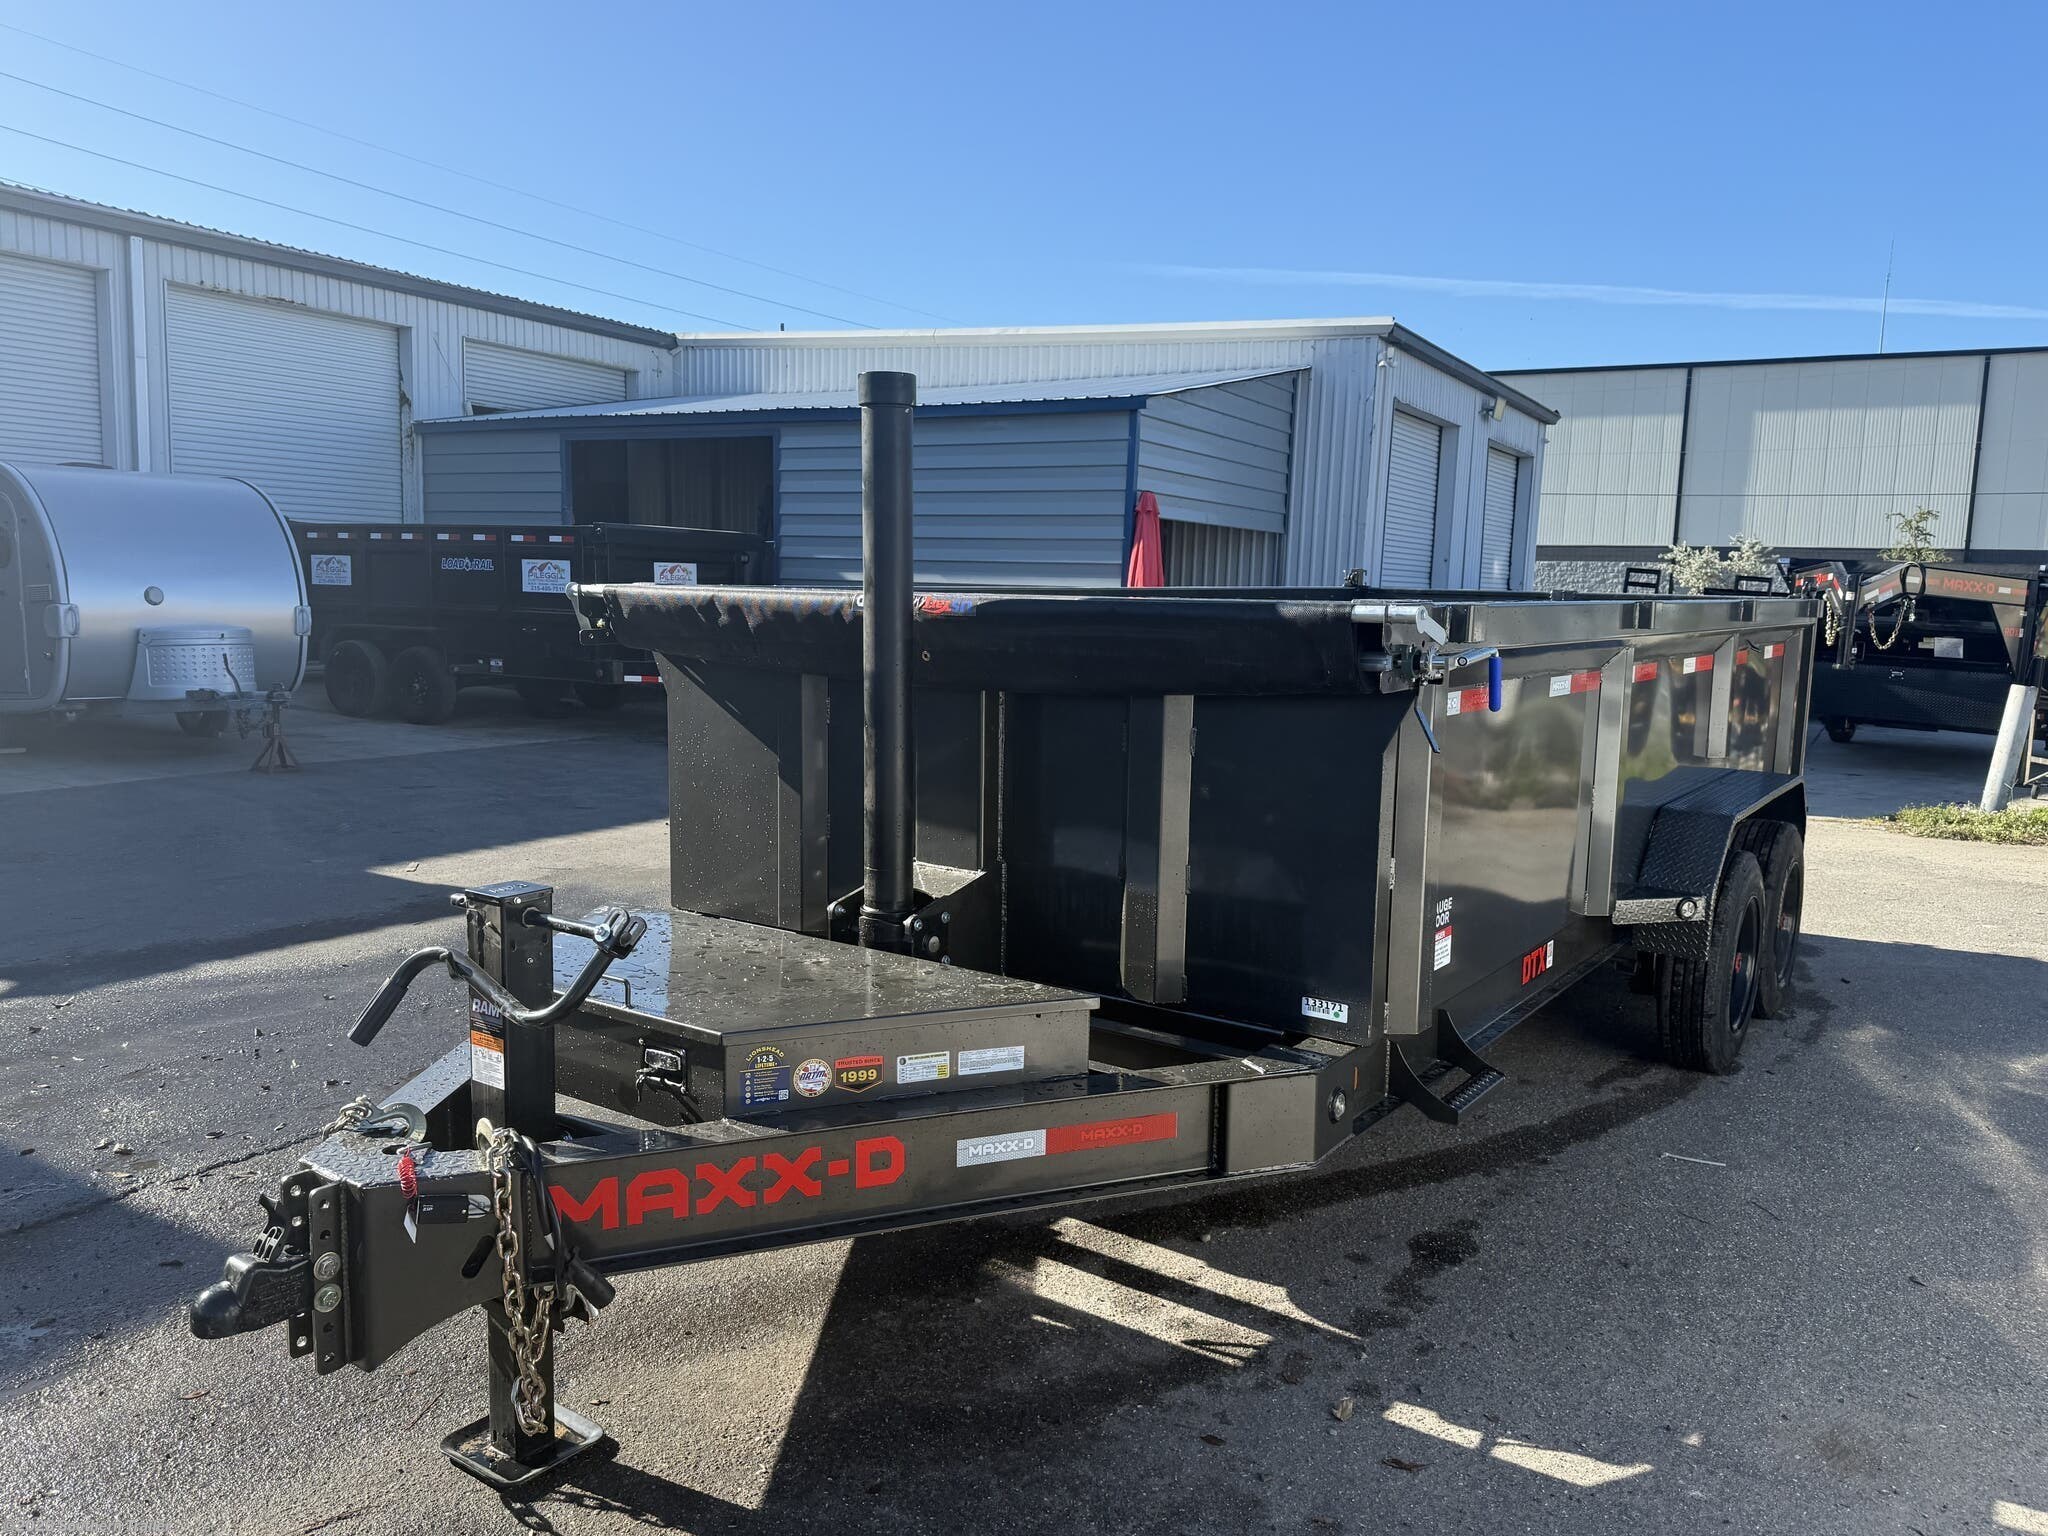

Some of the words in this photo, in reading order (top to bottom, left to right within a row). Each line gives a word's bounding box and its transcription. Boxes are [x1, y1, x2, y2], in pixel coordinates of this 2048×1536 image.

[441, 557, 465, 570] LOAD
[1522, 944, 1547, 985] DTX
[1304, 997, 1344, 1013] 133171
[745, 1046, 785, 1062] LIONSHEAD
[840, 1068, 877, 1083] 1999
[1080, 1124, 1143, 1141] MAXX-D
[968, 1138, 1034, 1158] MAXX-D
[548, 1135, 905, 1230] MAXX-D
